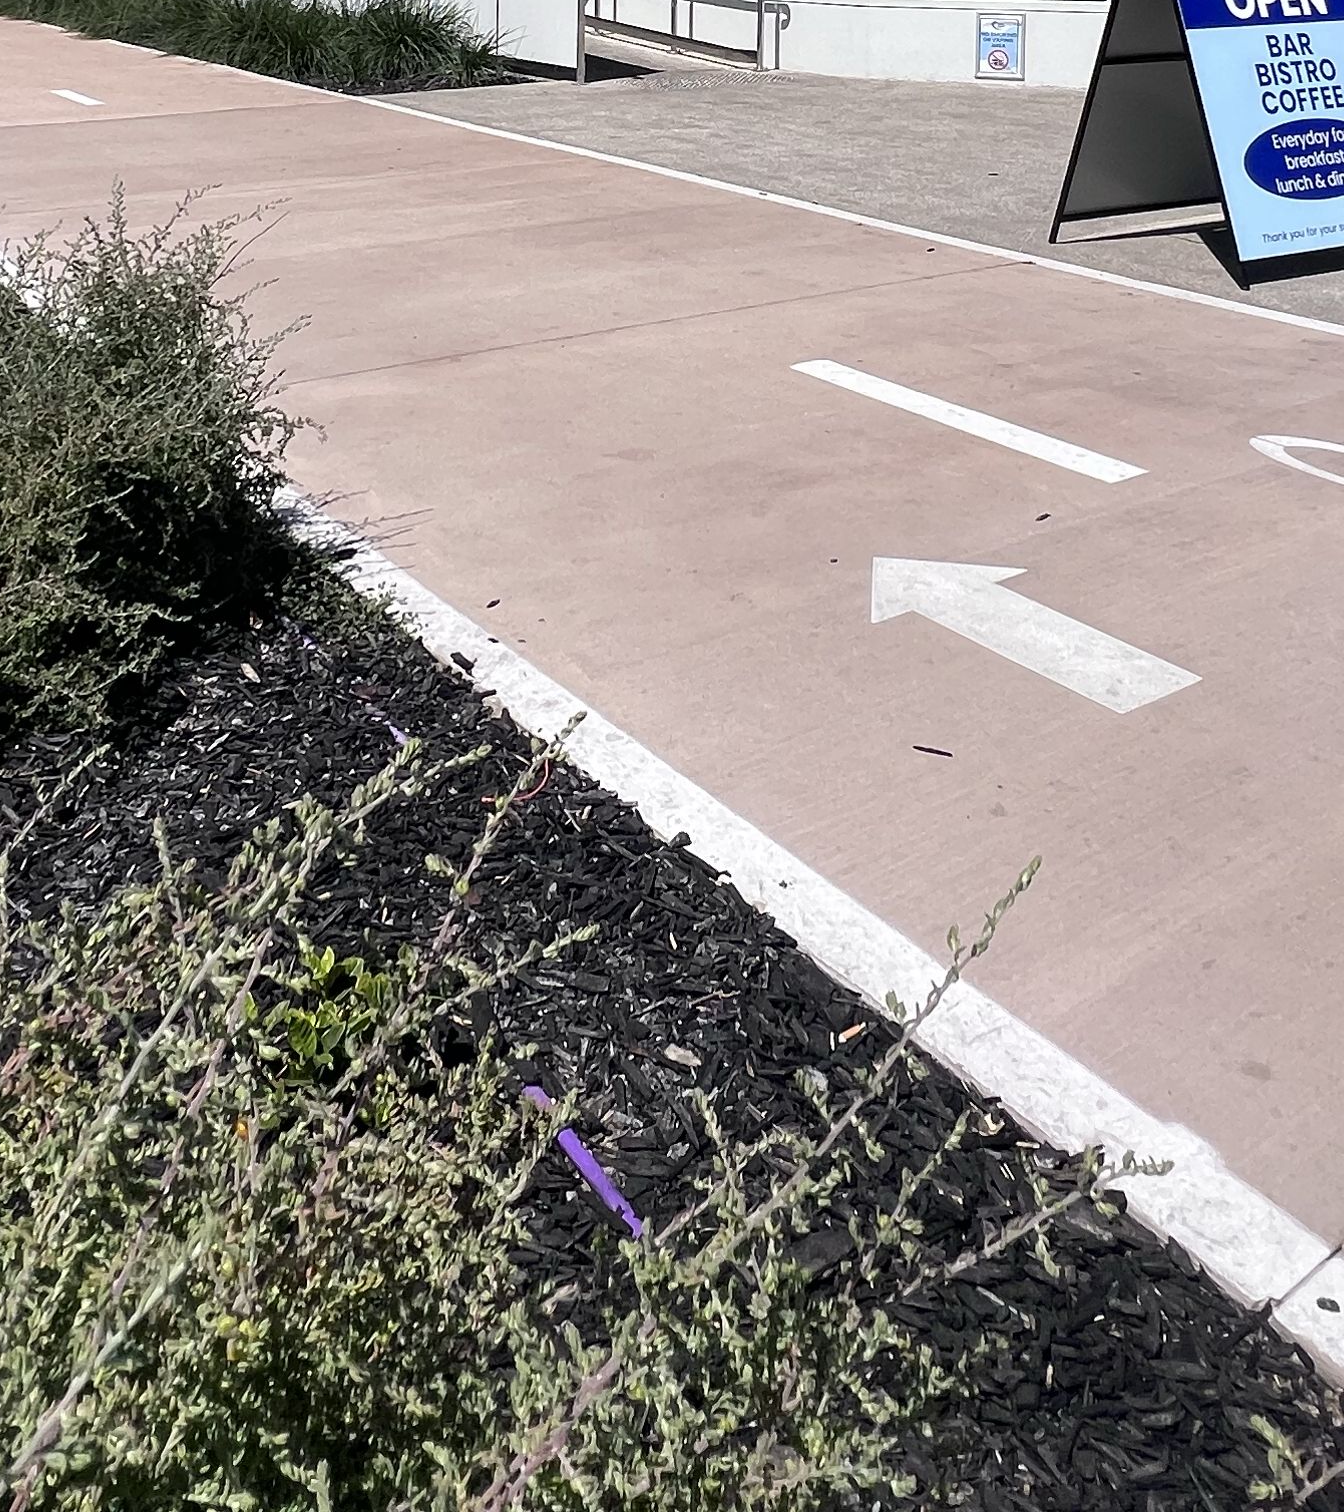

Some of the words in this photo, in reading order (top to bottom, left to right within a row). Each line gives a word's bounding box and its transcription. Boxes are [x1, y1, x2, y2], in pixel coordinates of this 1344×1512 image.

[1266, 33, 1314, 57] BAR
[1255, 58, 1336, 87] BISTRO
[1271, 129, 1330, 150] Everyday
[1275, 175, 1314, 194] lunch
[1315, 173, 1327, 189] &
[1262, 231, 1288, 243] Thank
[1290, 229, 1305, 241] you
[1306, 227, 1318, 237] for
[1319, 224, 1337, 237] your
